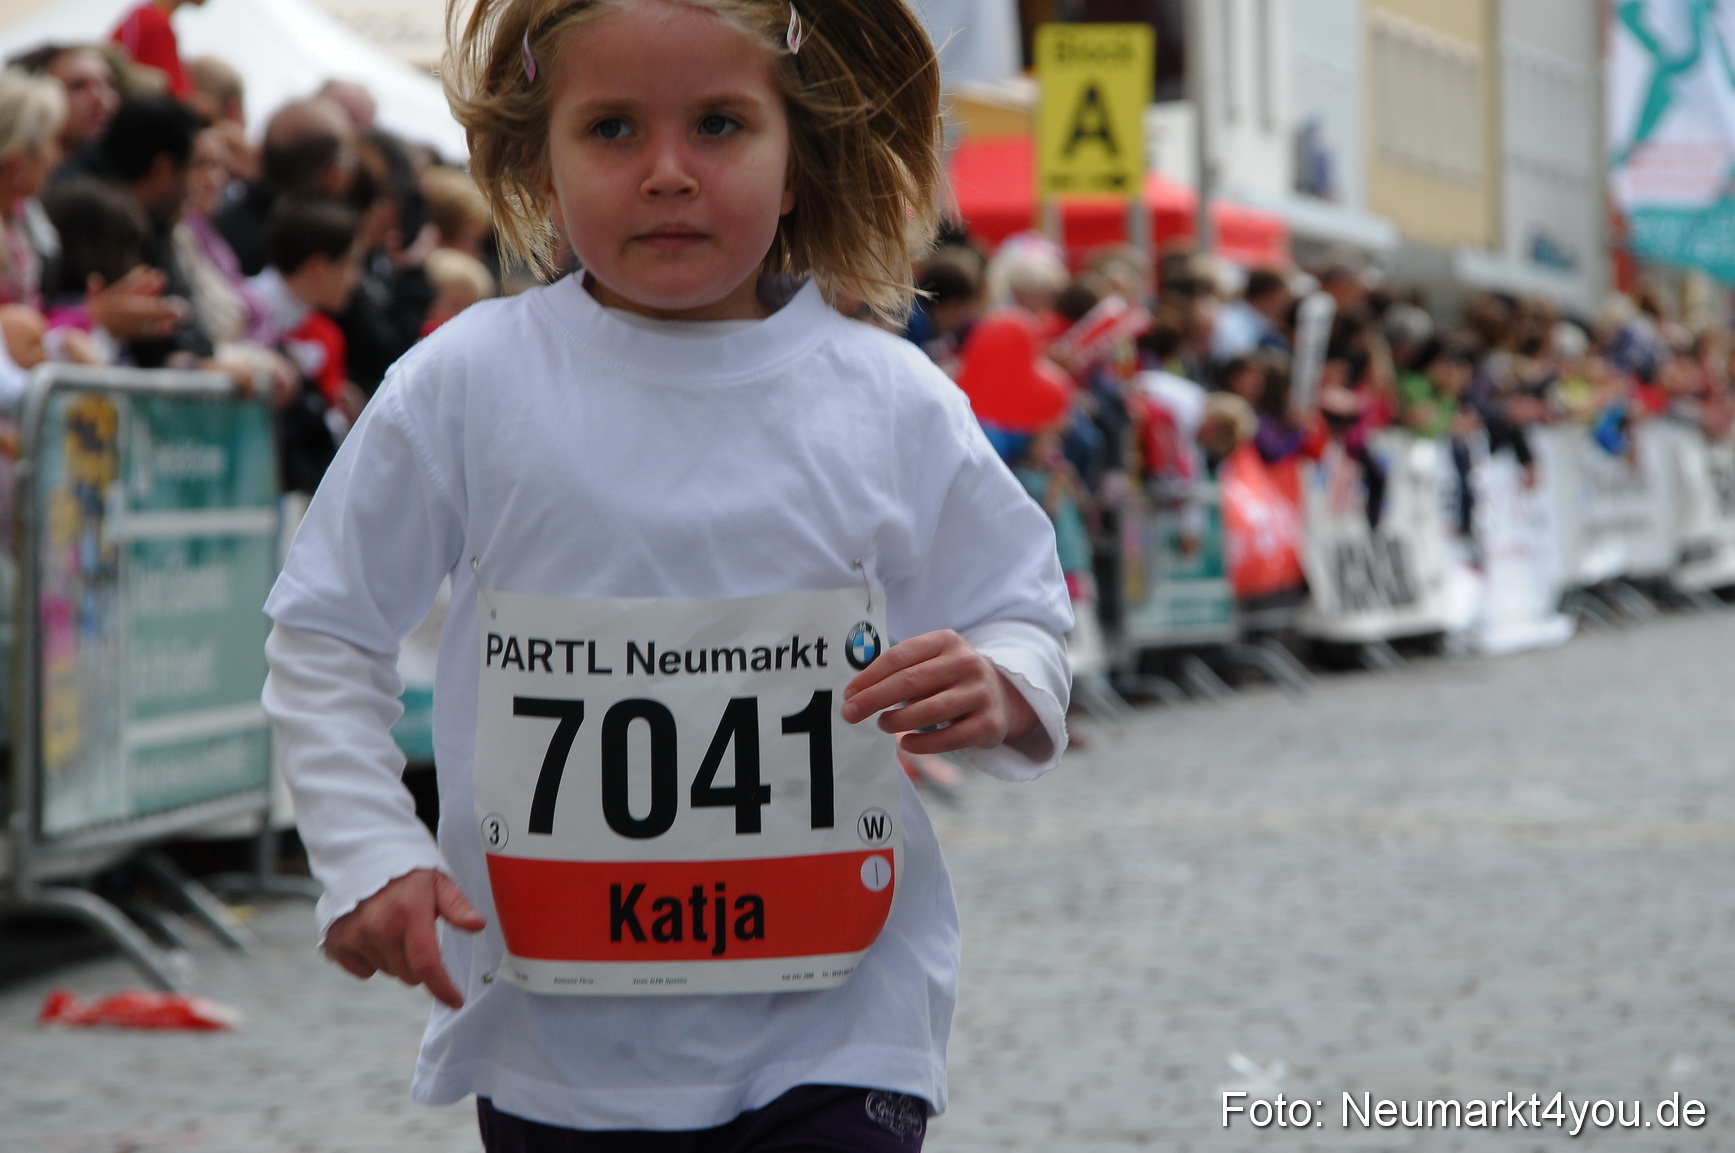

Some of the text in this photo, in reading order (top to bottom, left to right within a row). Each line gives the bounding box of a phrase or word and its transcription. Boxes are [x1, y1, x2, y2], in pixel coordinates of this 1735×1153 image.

[1061, 79, 1121, 157] A
[486, 633, 828, 676] PARTL Neumarkt
[512, 689, 835, 840] 7041
[489, 820, 500, 846] 3
[863, 815, 885, 841] W
[608, 882, 765, 956] Katja
